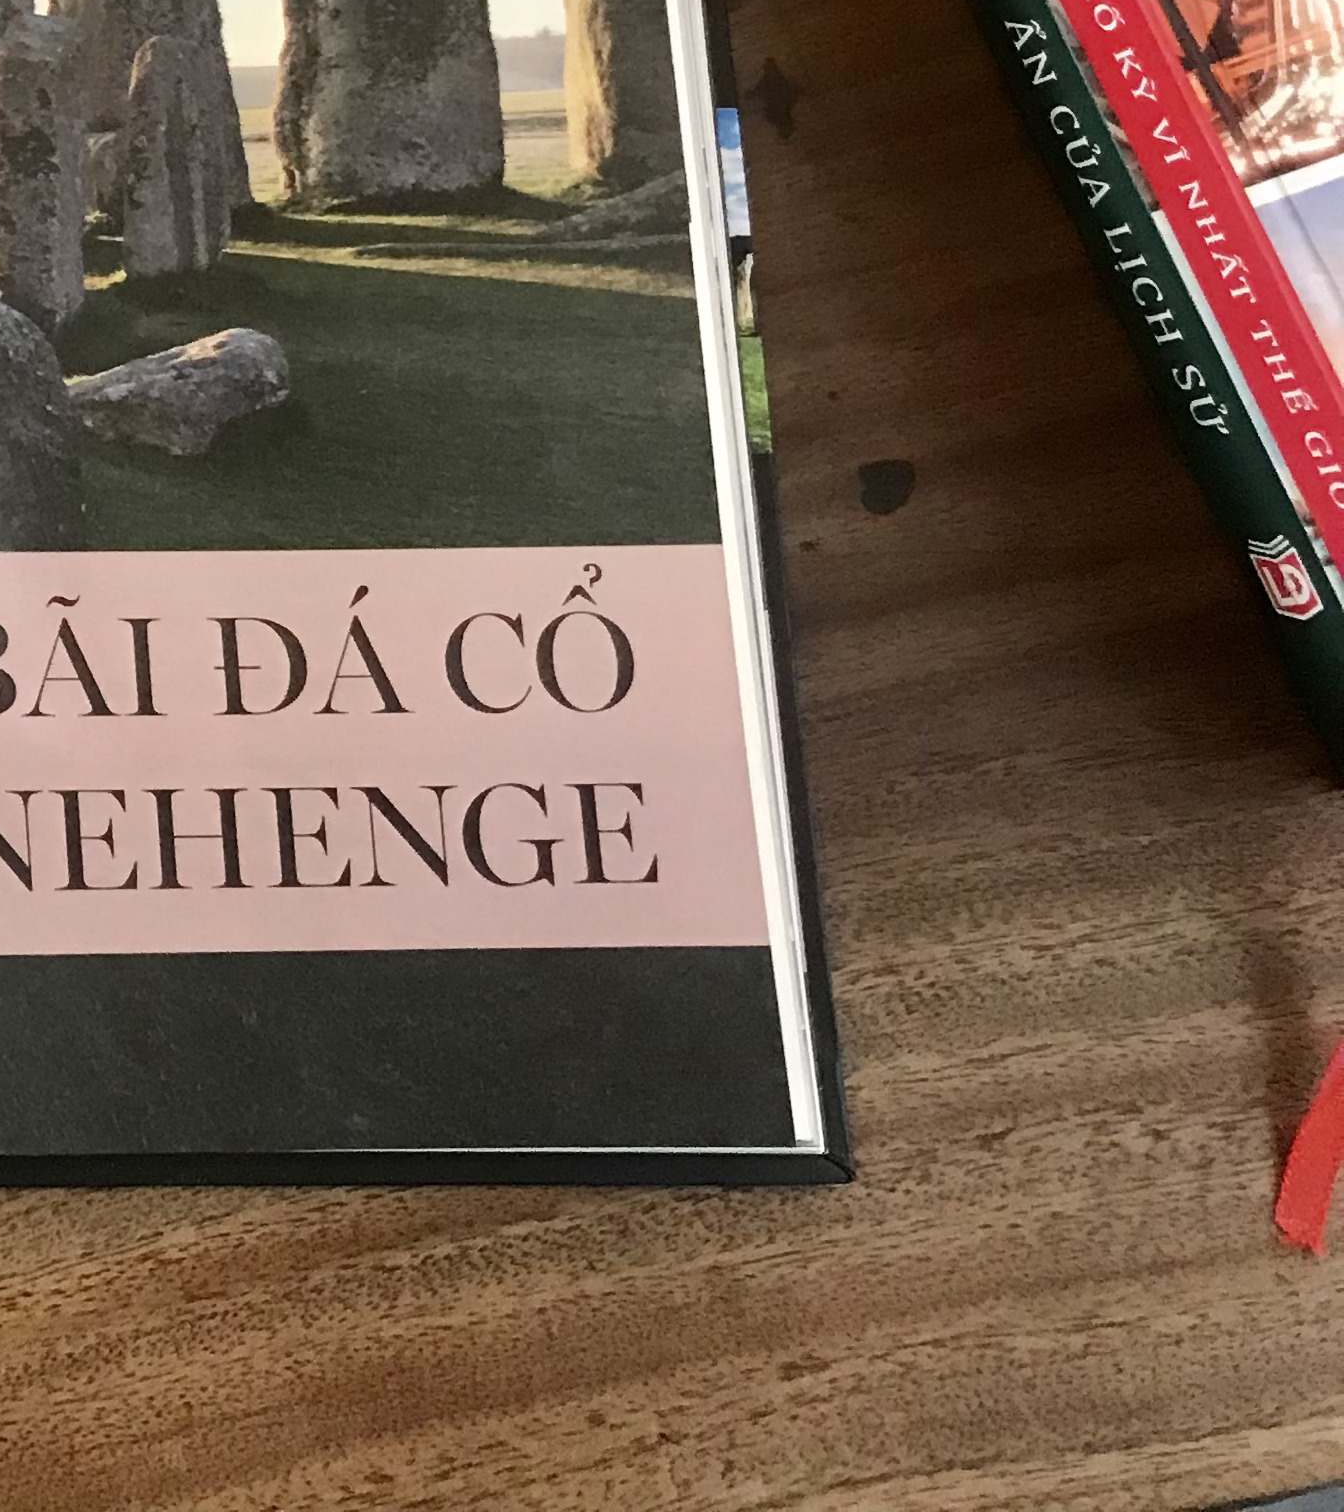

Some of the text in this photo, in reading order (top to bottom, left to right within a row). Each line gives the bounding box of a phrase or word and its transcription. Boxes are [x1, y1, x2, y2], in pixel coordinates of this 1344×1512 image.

[1050, 105, 1111, 208] CỦA
[1103, 222, 1184, 346] LỊCH
[1171, 364, 1230, 435] SỬ
[1112, 47, 1159, 104] KỲ
[1178, 180, 1257, 305] NHẤT
[1250, 319, 1320, 415] THẾ
[206, 585, 416, 716] ĐÁ
[443, 562, 637, 715] CỔ
